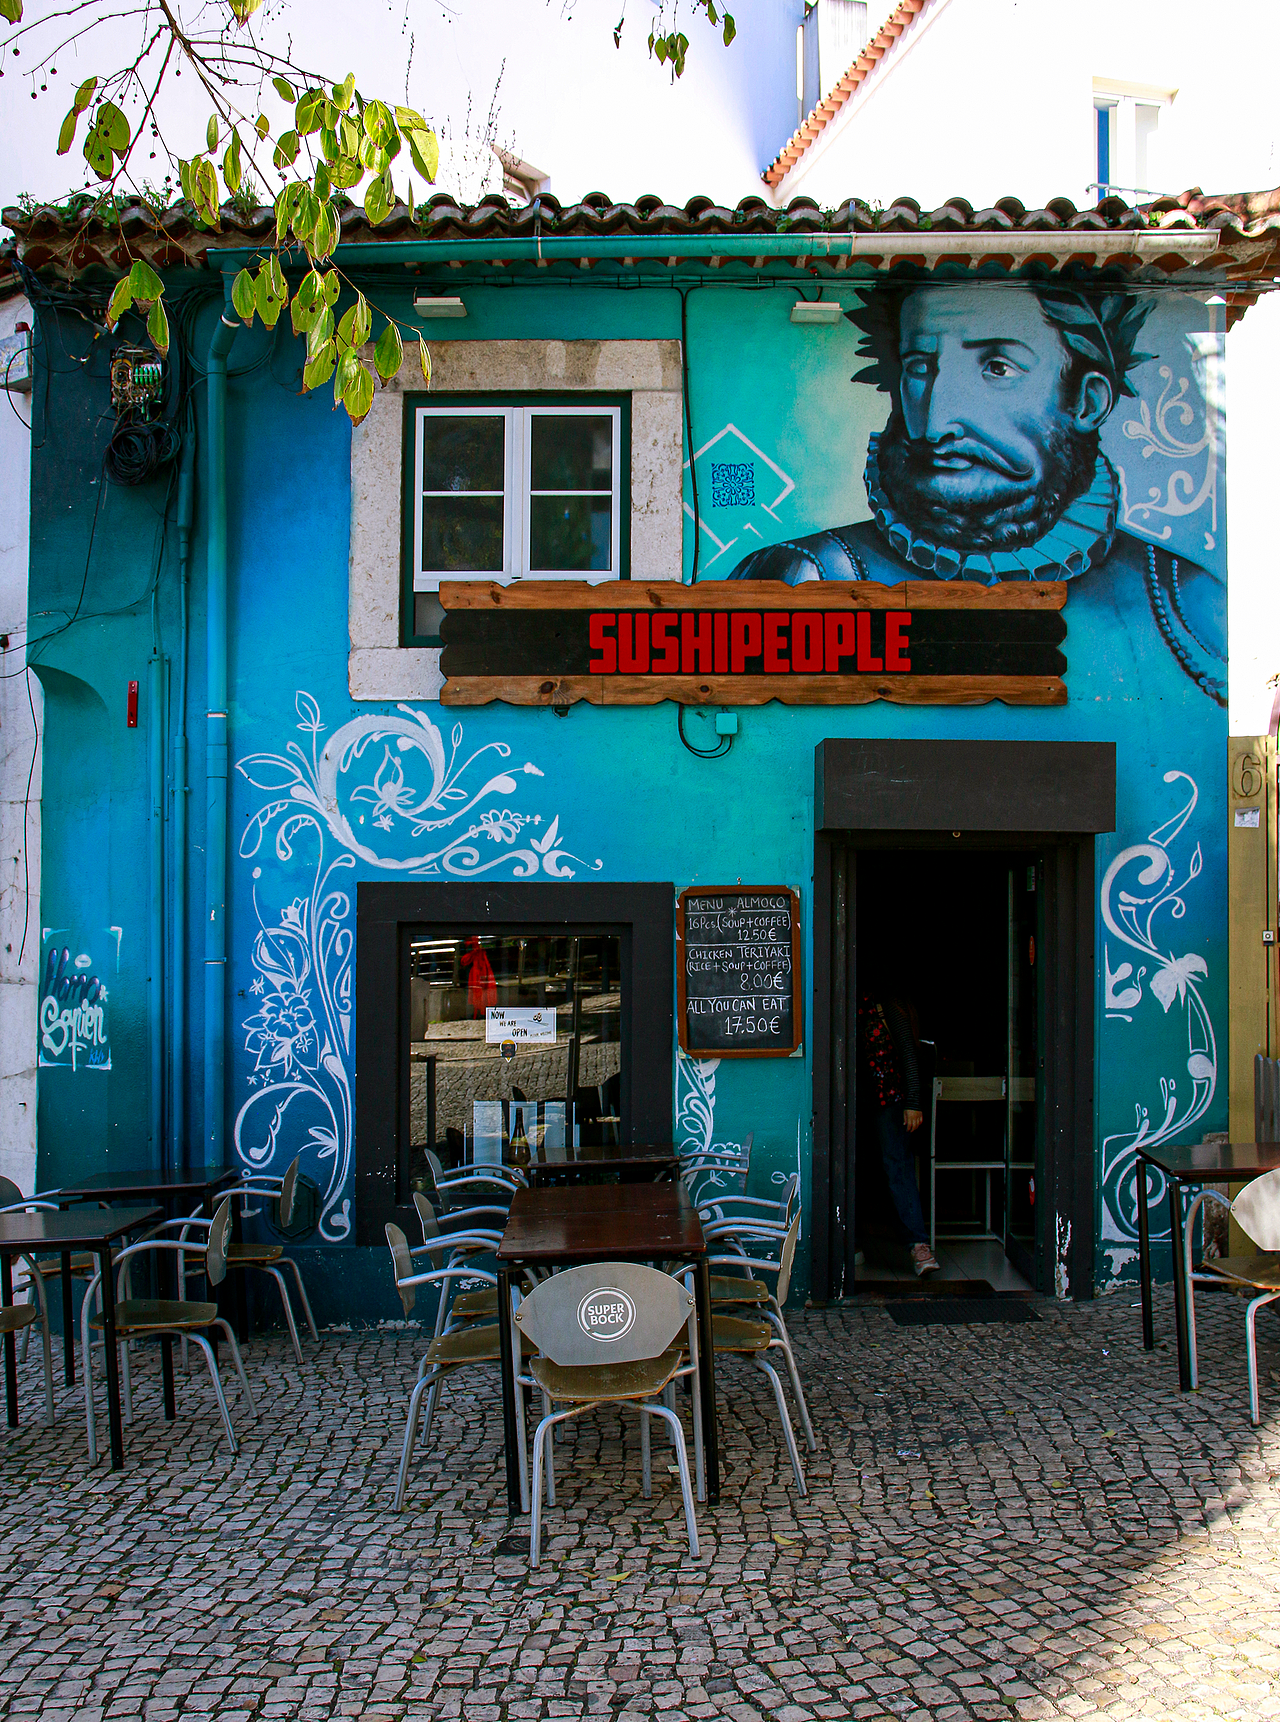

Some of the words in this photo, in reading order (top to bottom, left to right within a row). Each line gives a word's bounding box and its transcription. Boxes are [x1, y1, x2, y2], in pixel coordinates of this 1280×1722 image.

[589, 611, 912, 673] SUSHIPEOPLE
[1232, 753, 1262, 797] 6
[688, 898, 724, 911] MENU
[737, 927, 777, 942] 12.50€
[688, 948, 734, 960] CHICKEN
[736, 945, 791, 959] TERIYAKI
[740, 971, 784, 991] 8.00€
[686, 1000, 707, 1014] ALL
[708, 998, 730, 1014] YOU
[732, 998, 756, 1012] CAN
[762, 998, 787, 1011] EAT
[490, 1011, 505, 1020] NOW
[511, 1028, 528, 1037] OPEN
[724, 1015, 781, 1035] 17.50€
[587, 1303, 625, 1316] SUPER
[590, 1313, 624, 1326] BOCK
